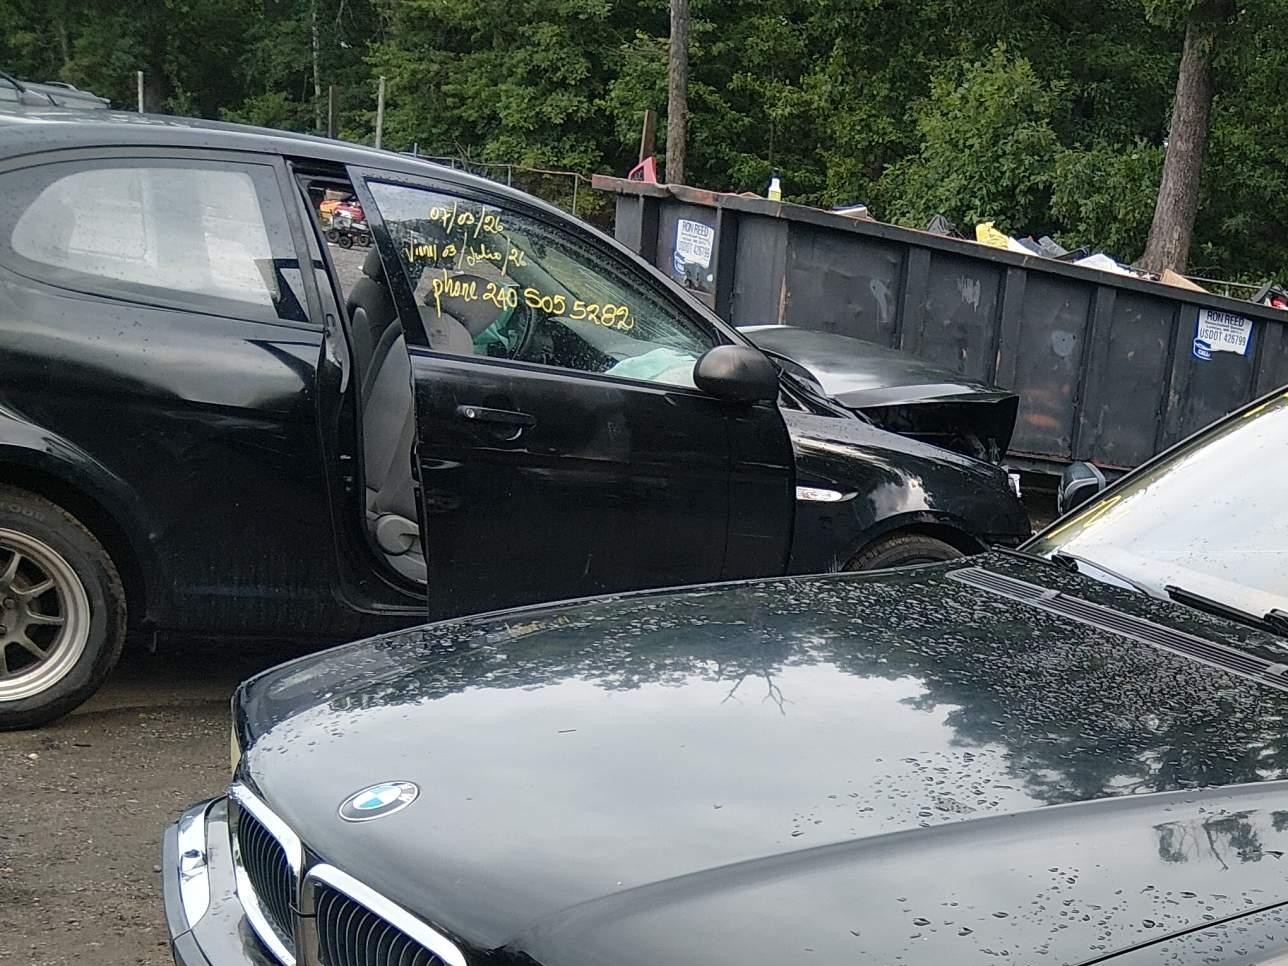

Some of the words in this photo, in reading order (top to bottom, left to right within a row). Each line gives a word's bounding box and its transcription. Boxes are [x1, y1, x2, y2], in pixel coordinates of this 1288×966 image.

[483, 283, 517, 310] 240
[570, 302, 634, 330] 5282
[1207, 310, 1224, 323] RON
[1225, 314, 1244, 327] REED
[1200, 328, 1222, 341] USDOT
